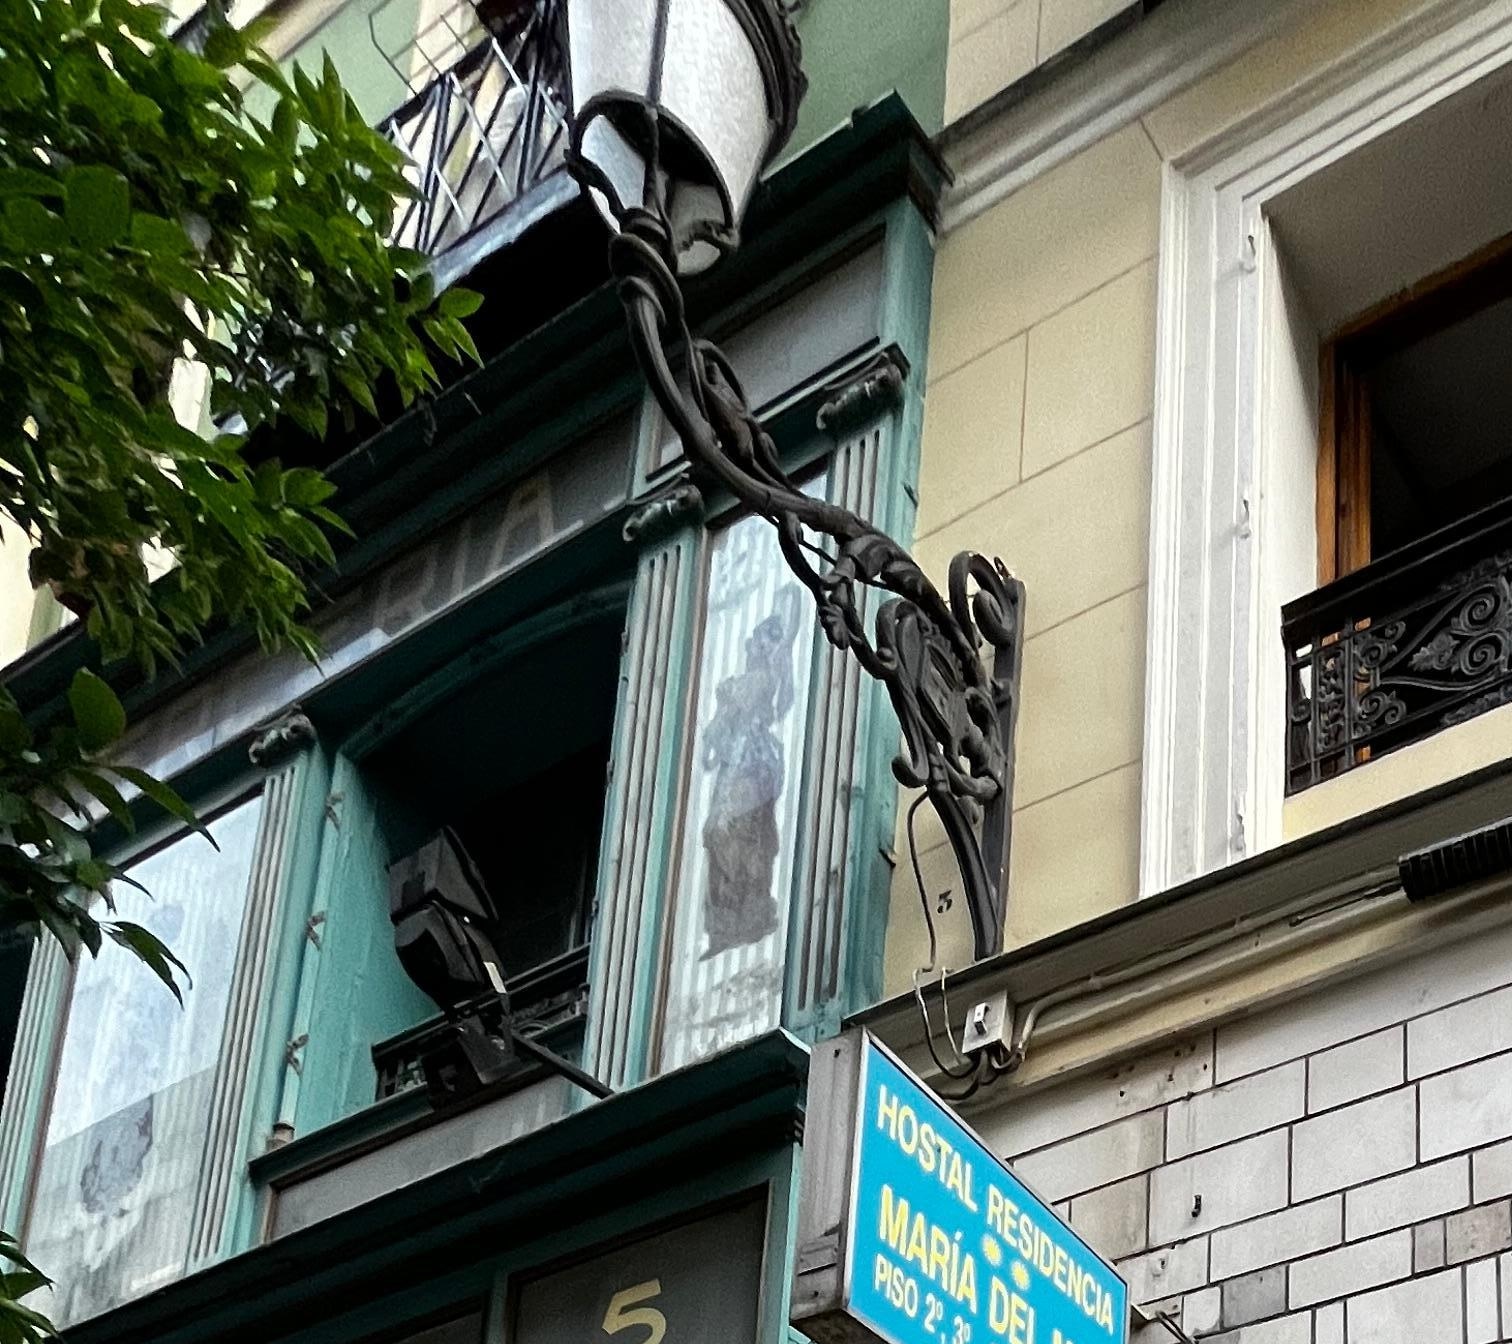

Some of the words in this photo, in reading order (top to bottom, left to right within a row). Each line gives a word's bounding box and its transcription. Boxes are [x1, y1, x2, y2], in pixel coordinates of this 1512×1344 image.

[877, 1084, 978, 1212] HOSTAL
[987, 1183, 1114, 1336] RESIDENCIA
[879, 1183, 978, 1315] MARÍA
[874, 1253, 919, 1319] PISO
